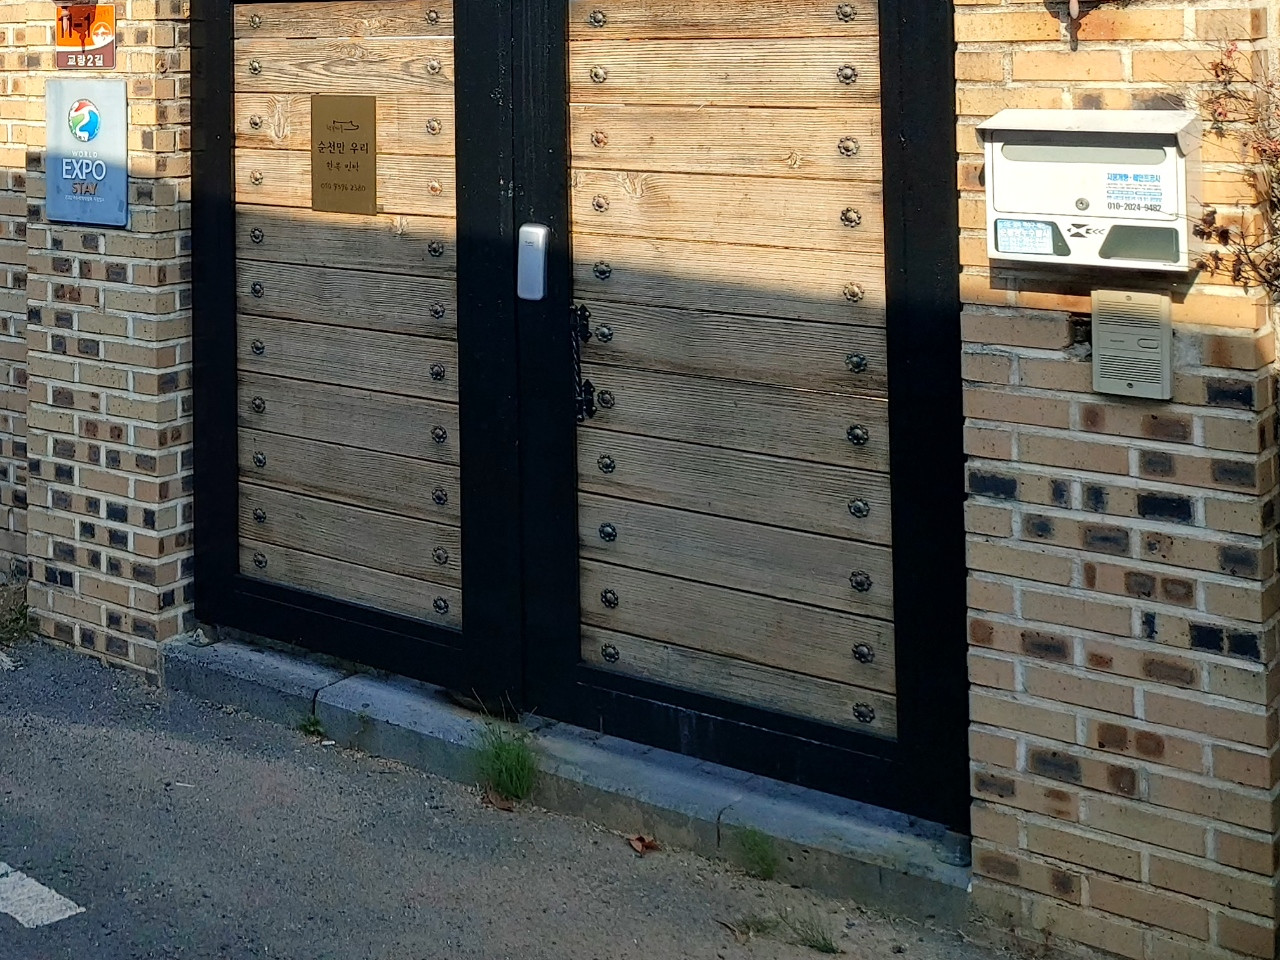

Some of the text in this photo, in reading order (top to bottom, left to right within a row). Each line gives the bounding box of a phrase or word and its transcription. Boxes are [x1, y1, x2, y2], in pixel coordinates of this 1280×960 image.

[71, 150, 98, 158] WORLD
[317, 140, 369, 155] 순천만 우리
[62, 158, 106, 181] EXPO
[344, 161, 360, 172] 민박
[72, 182, 98, 195] STAY
